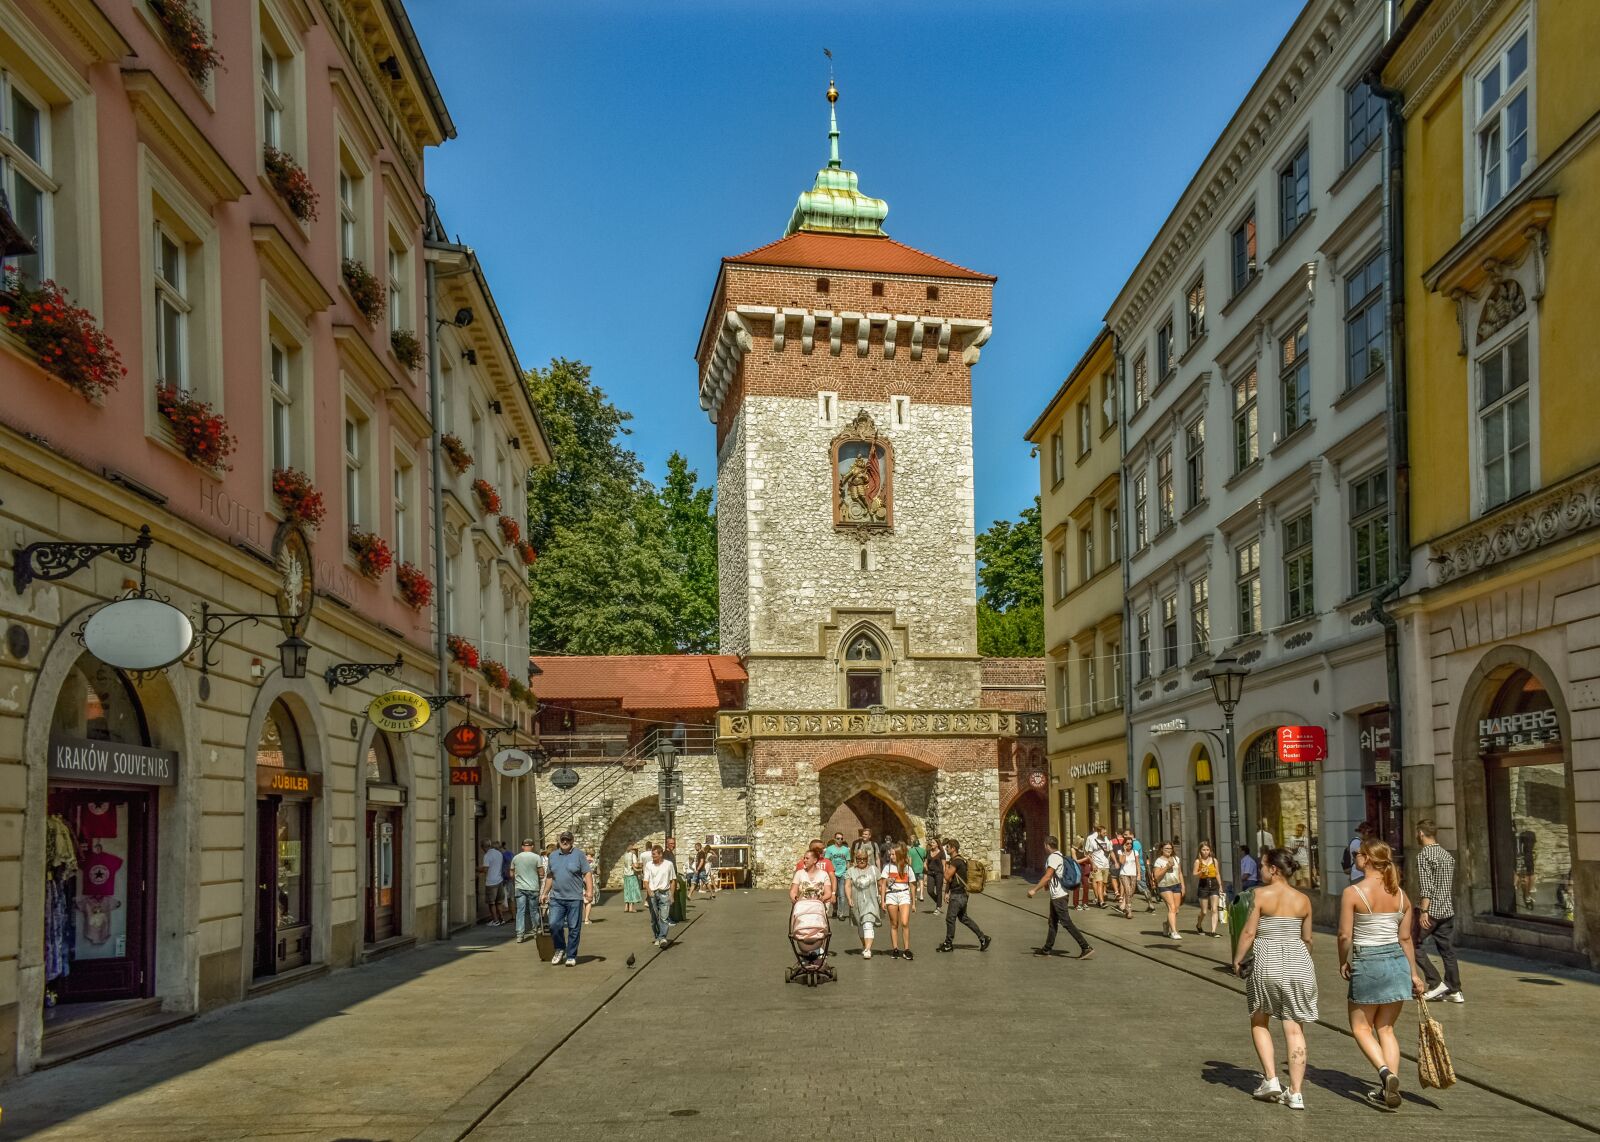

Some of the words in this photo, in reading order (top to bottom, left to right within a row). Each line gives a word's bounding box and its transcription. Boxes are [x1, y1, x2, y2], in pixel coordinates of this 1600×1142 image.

[200, 479, 266, 549] HOTEL
[374, 694, 424, 709] JEWELLERY
[378, 717, 421, 729] JUBILER
[1479, 708, 1558, 736] HARPERS
[1479, 729, 1560, 748] SHOES
[57, 743, 109, 772] KRAKÓW
[113, 752, 169, 778] SOUVENIRS
[1070, 763, 1087, 779] COSTA
[1087, 760, 1109, 775] COFFEE
[272, 775, 309, 791] JUBILER
[452, 771, 468, 782] 24
[470, 771, 479, 782] h
